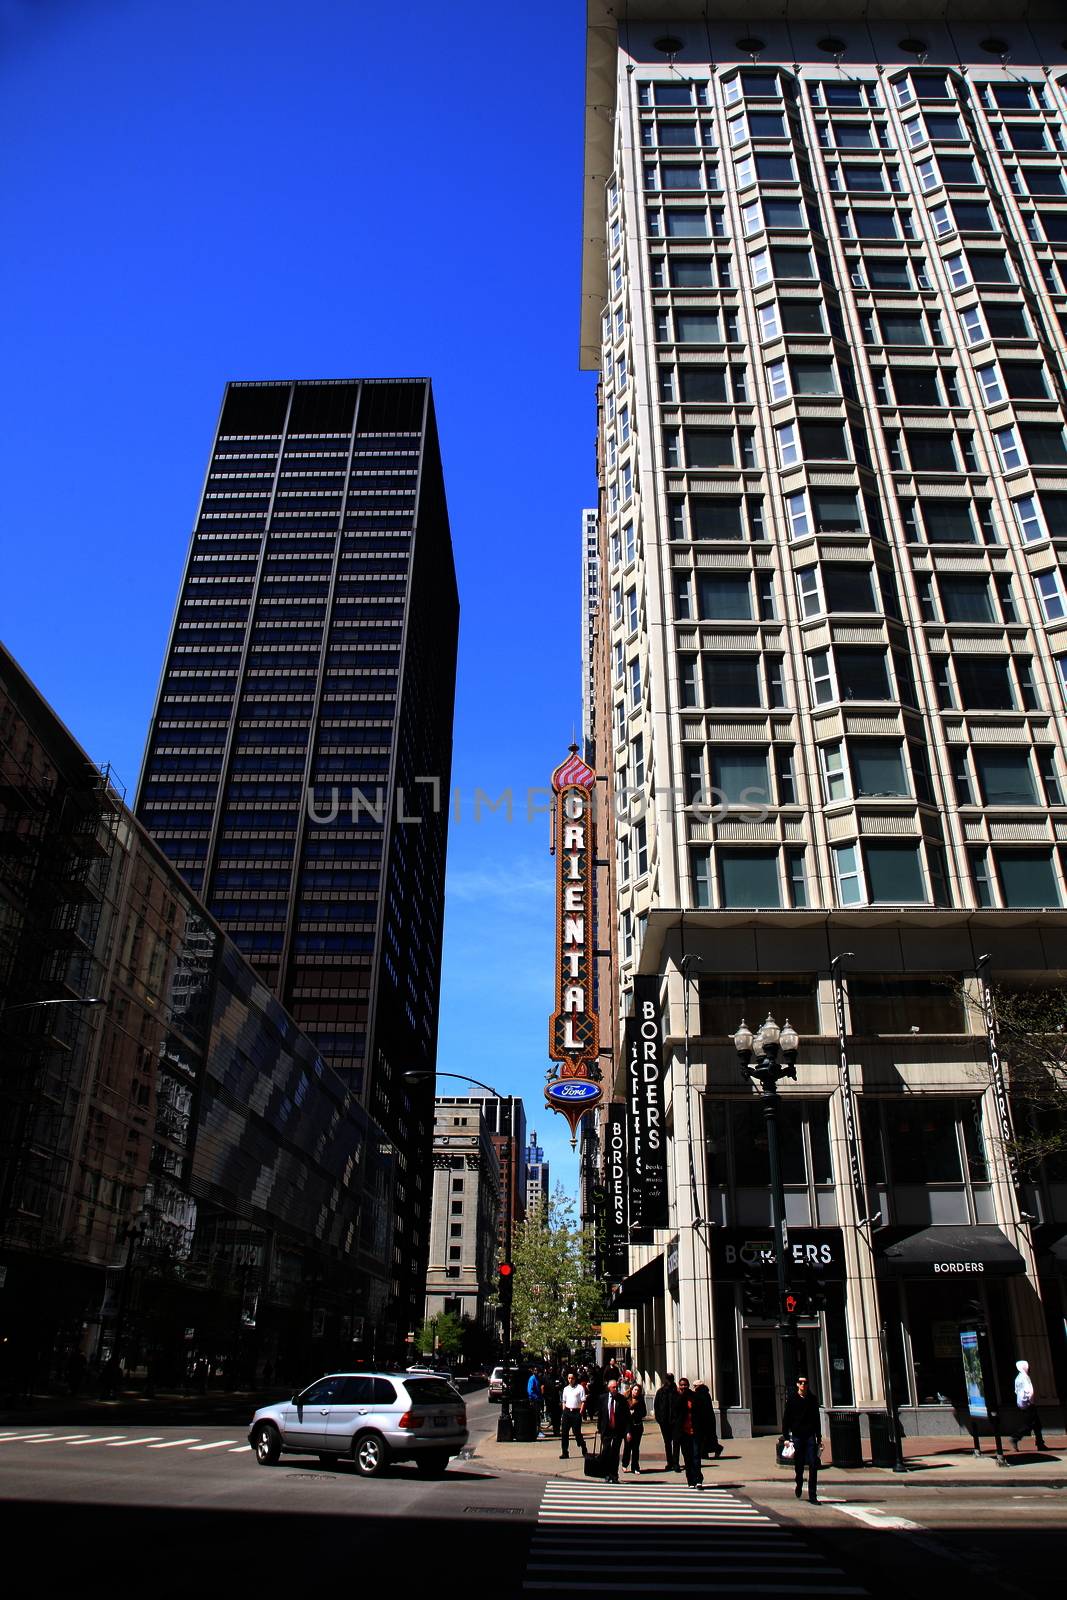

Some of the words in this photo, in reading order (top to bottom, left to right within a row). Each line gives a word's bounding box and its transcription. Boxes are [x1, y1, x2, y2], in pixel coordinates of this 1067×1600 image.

[563, 796, 586, 1049] ORIENTAL
[561, 1085, 587, 1096] Ford
[640, 1001, 660, 1149] BORDERS
[611, 1122, 624, 1225] BORDERS
[725, 1244, 832, 1264] BORERS
[934, 1262, 985, 1273] BORDERS
